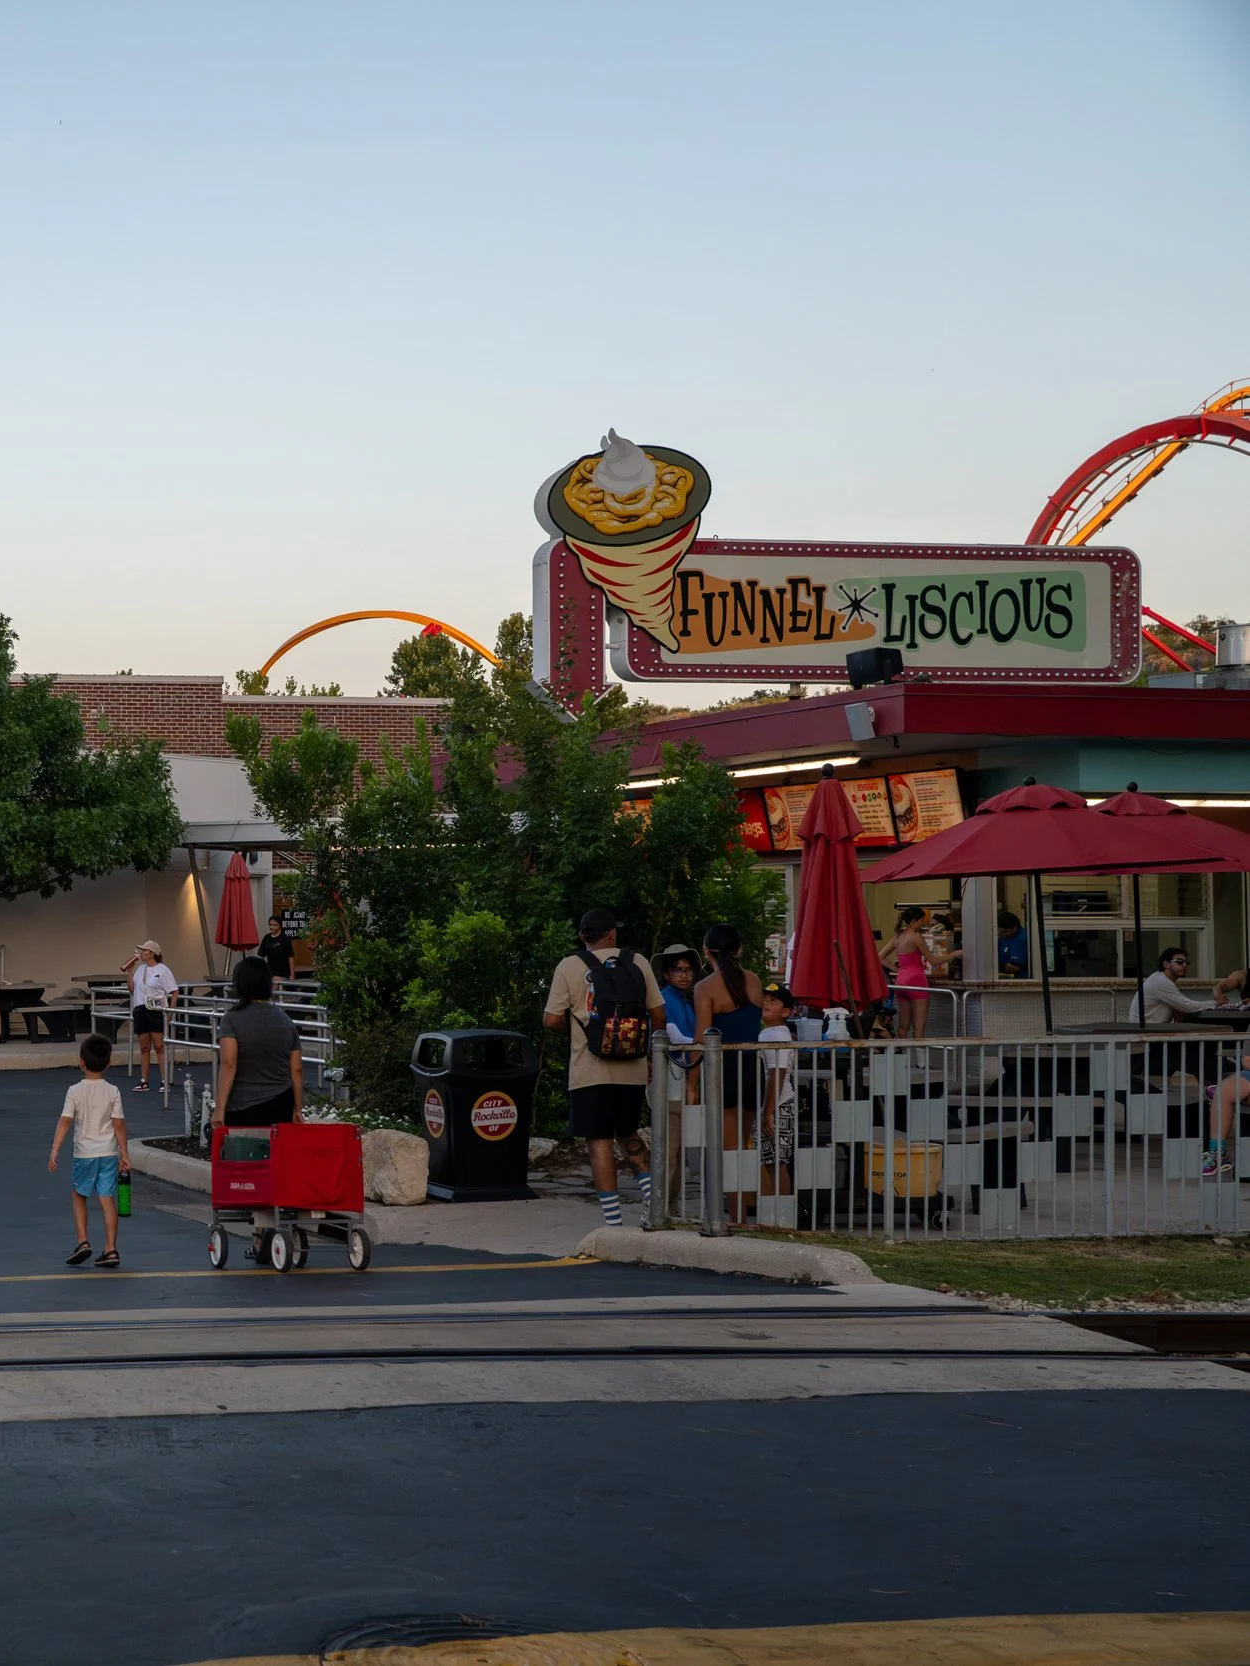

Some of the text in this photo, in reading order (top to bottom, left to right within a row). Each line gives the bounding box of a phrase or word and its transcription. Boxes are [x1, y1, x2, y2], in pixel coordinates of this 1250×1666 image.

[677, 570, 1072, 649] FUNNEL LISCIOUS
[483, 1099, 503, 1108] CITY
[473, 1109, 516, 1122] Rockville
[488, 1124, 500, 1132] OF
